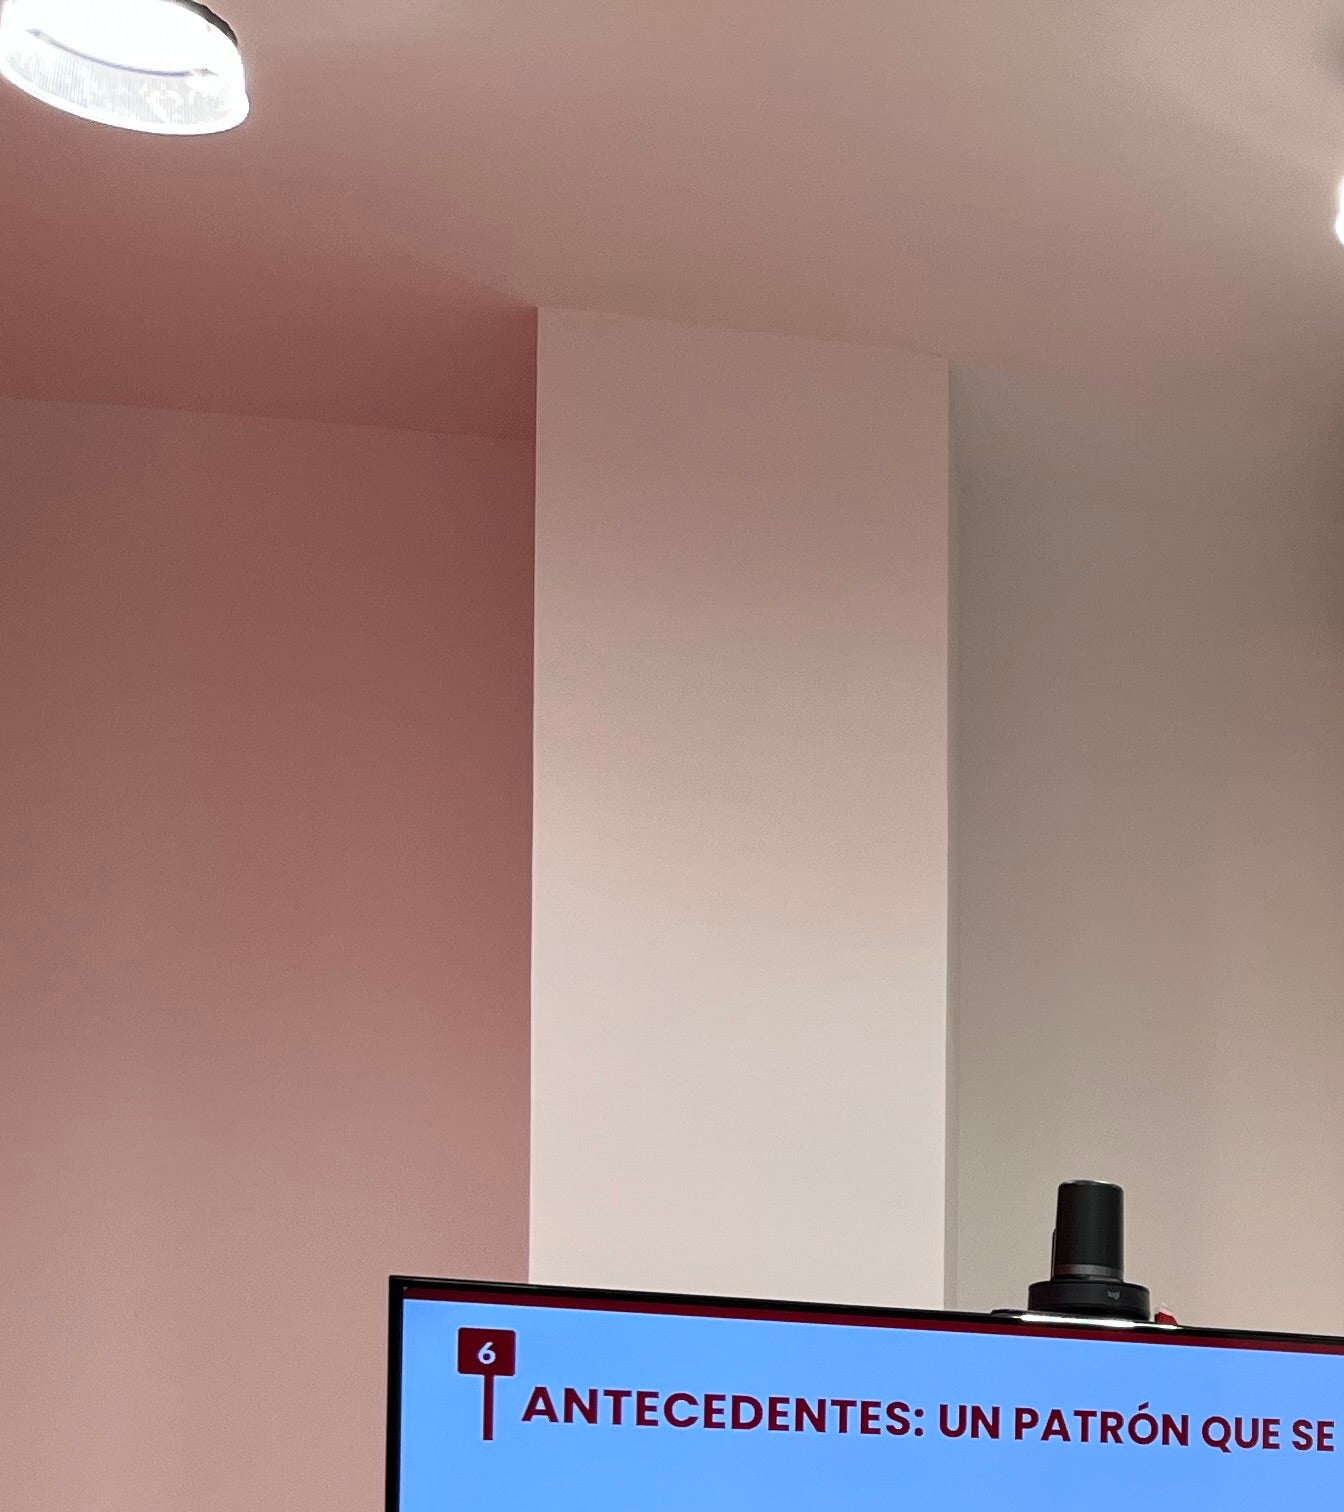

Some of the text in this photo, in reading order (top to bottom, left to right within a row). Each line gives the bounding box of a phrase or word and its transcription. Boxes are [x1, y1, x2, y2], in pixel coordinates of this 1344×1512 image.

[478, 1341, 496, 1365] 6
[521, 1386, 924, 1437] ANTECEDENTES:
[939, 1404, 1000, 1440] UN
[1014, 1402, 1189, 1447] PATRÓN
[1202, 1416, 1281, 1453] QUE
[1292, 1419, 1334, 1452] SE
